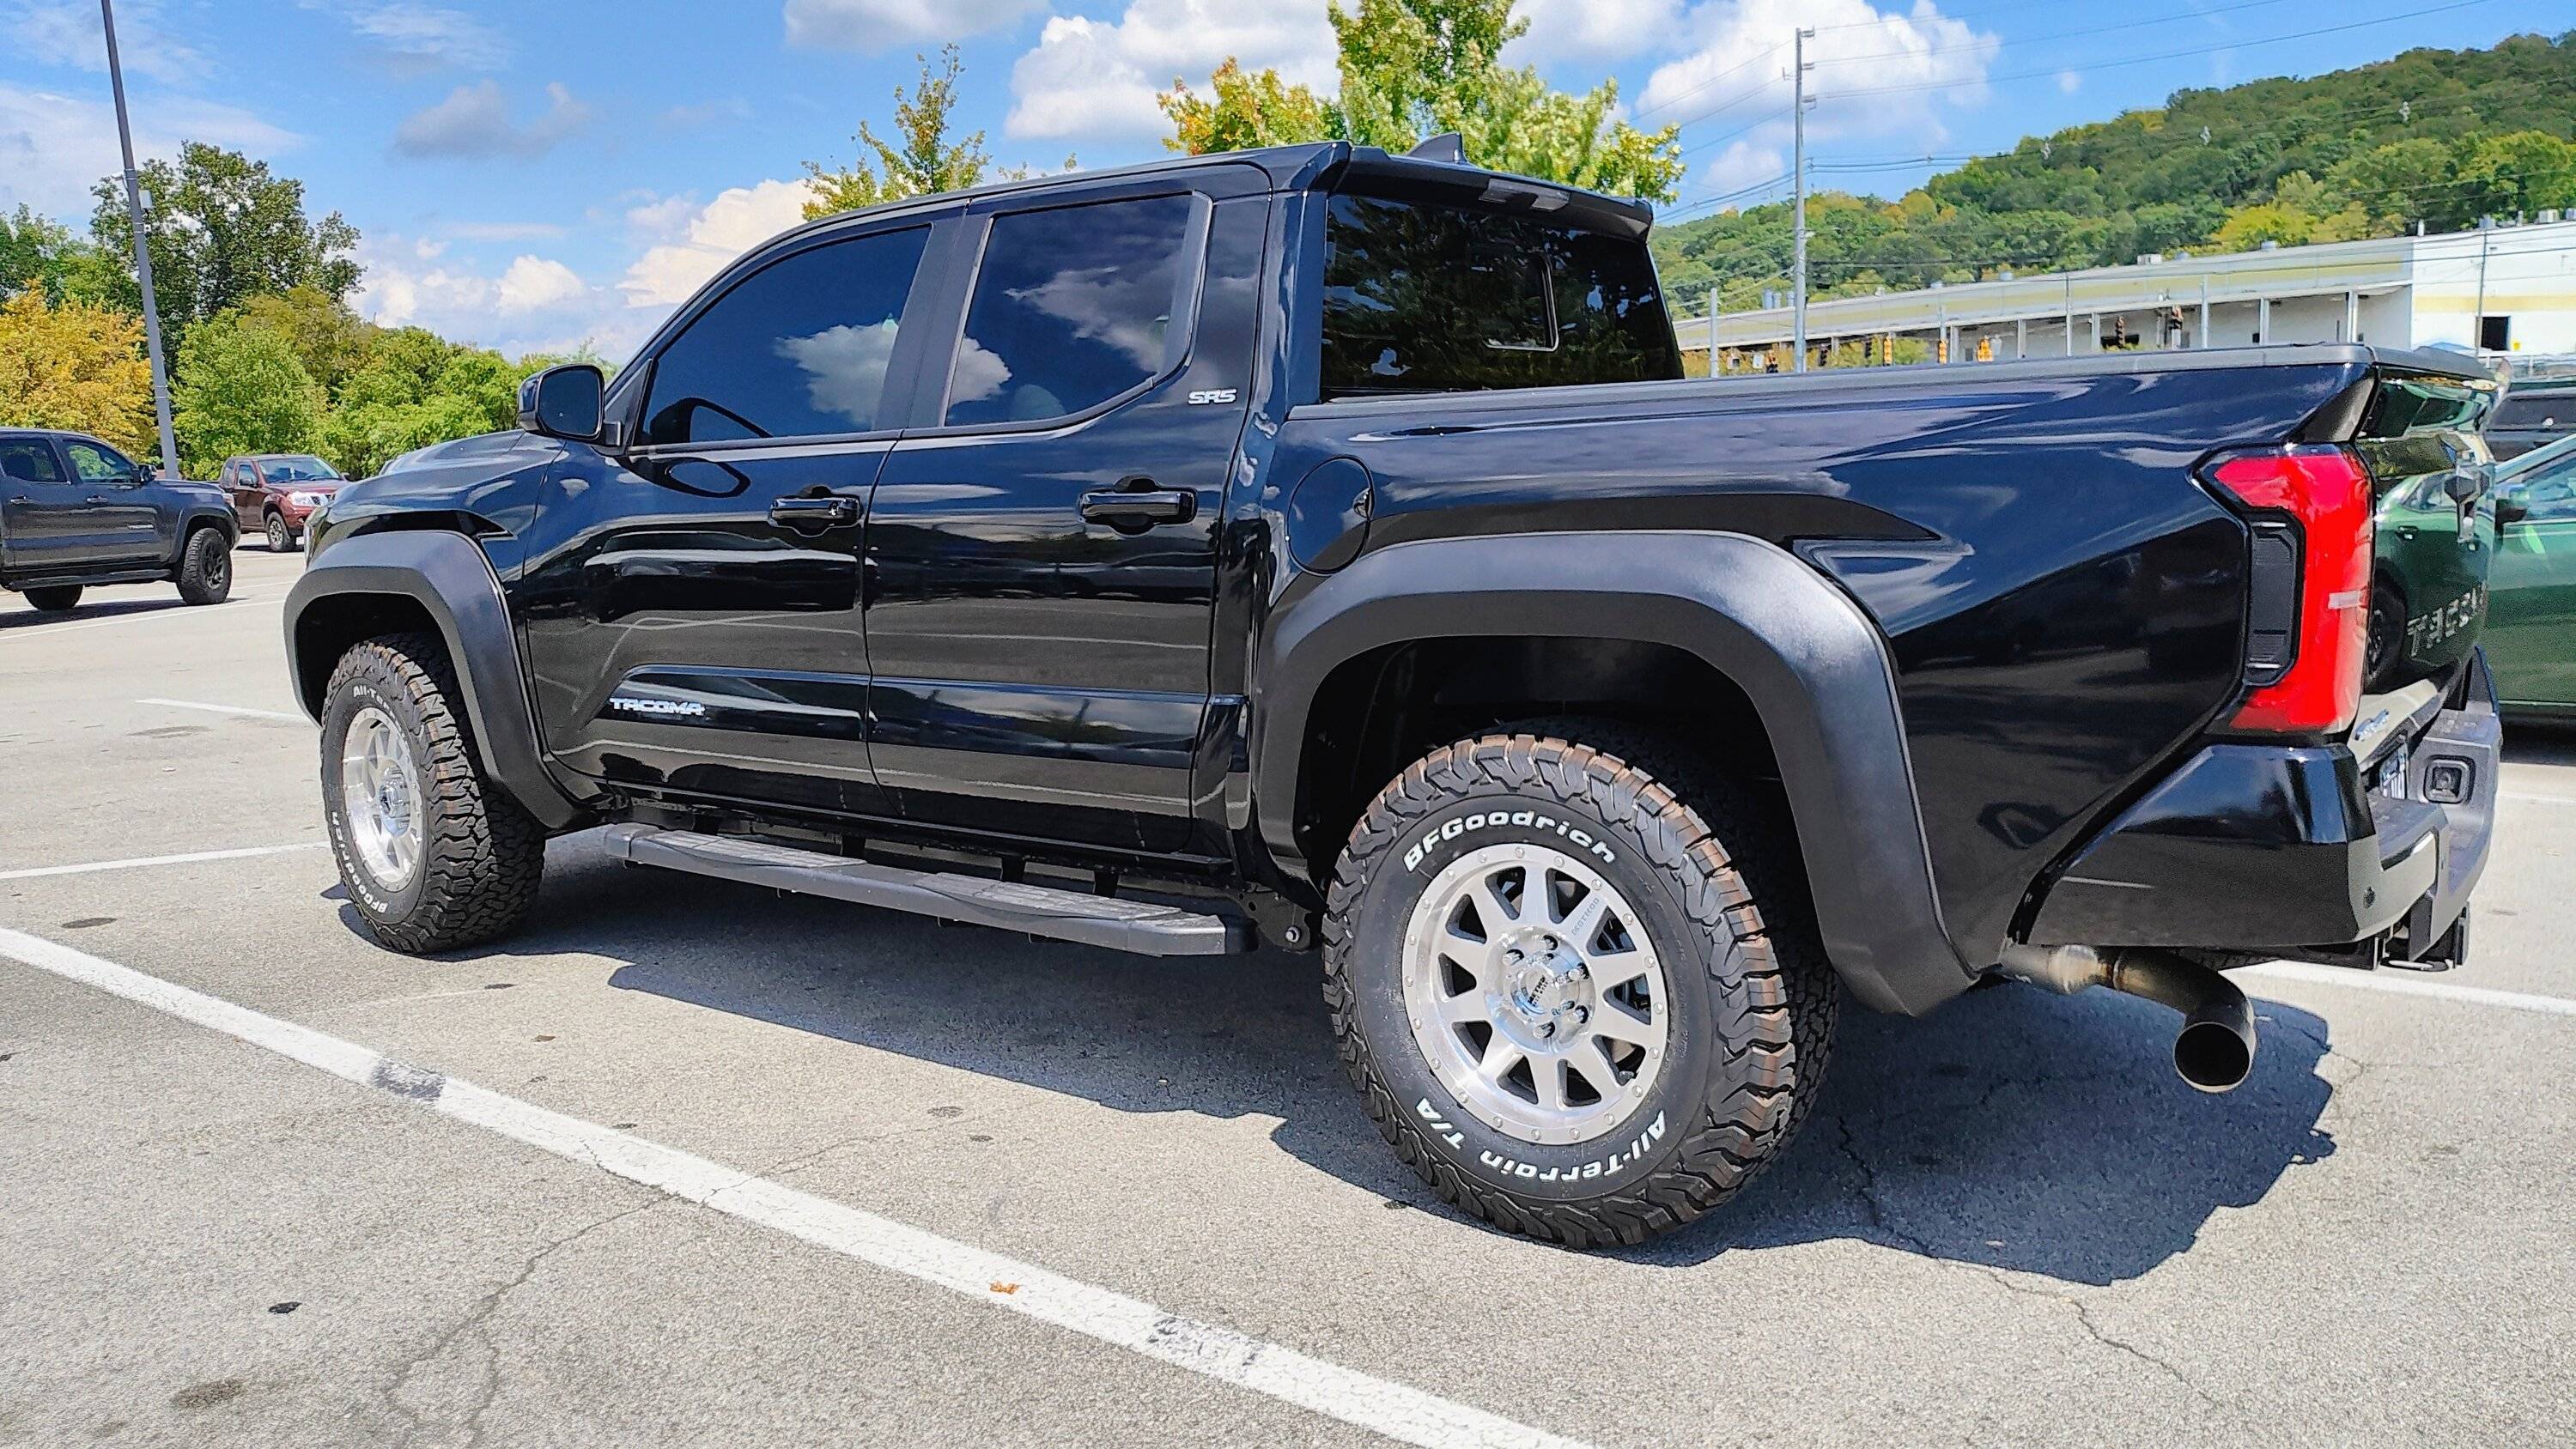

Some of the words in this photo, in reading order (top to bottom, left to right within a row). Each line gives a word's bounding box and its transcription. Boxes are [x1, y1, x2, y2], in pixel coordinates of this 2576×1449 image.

[1188, 388, 1236, 404] SR5
[2407, 582, 2486, 658] TACO
[609, 697, 706, 716] TACOMA
[1403, 810, 1615, 872] BFGoodrich
[1416, 1098, 1465, 1149] T/A
[1479, 1110, 1666, 1181] All-Terrain
